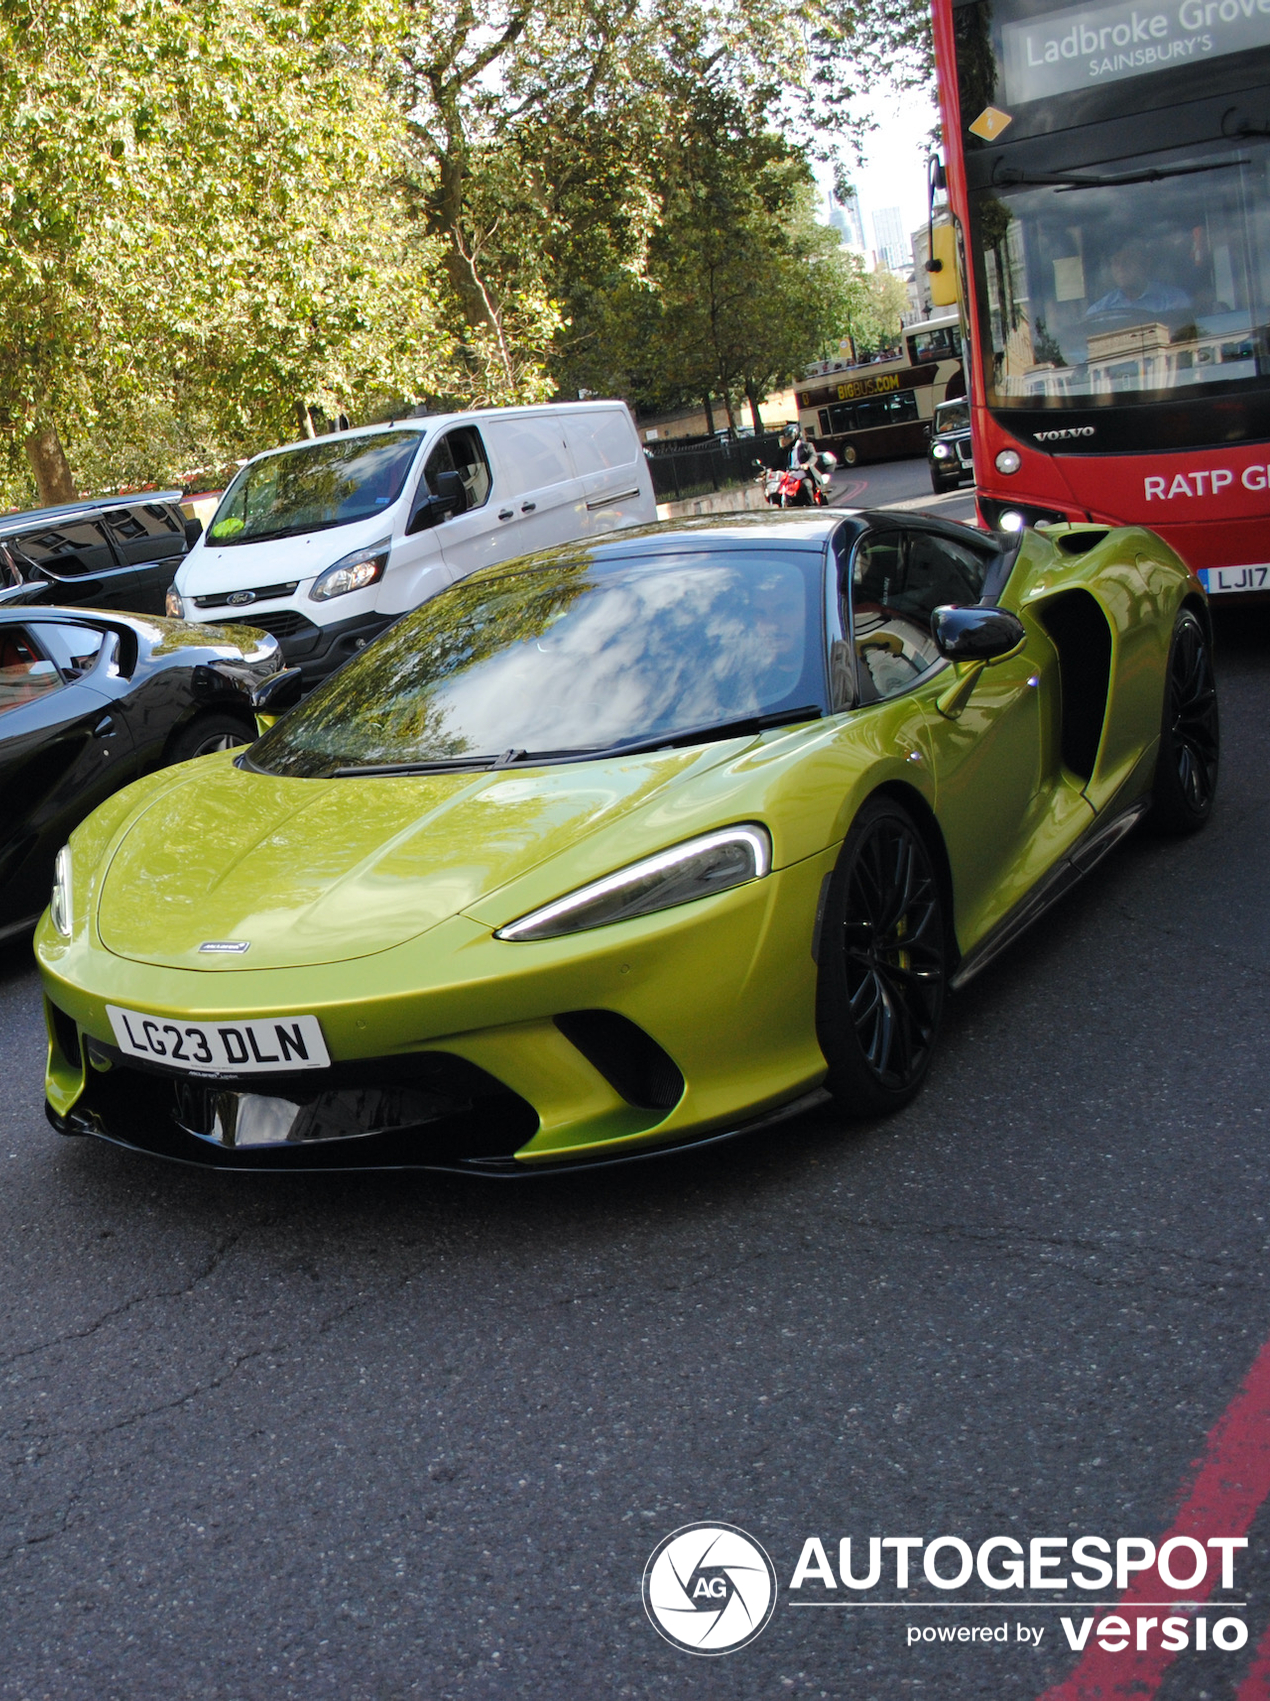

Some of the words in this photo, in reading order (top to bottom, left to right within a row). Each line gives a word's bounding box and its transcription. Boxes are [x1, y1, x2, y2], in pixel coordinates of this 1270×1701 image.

[1026, 13, 1168, 66] Ladbroke
[1088, 34, 1213, 76] SAINSBURY'S
[837, 374, 900, 400] BIGBUS.COM
[1033, 426, 1095, 442] VOLVO
[1144, 469, 1233, 501] RATP
[1241, 464, 1270, 491] G
[1218, 567, 1268, 590] LJ17
[231, 592, 249, 604] Ford
[121, 1014, 213, 1064] LG23
[217, 1023, 310, 1064] DLN
